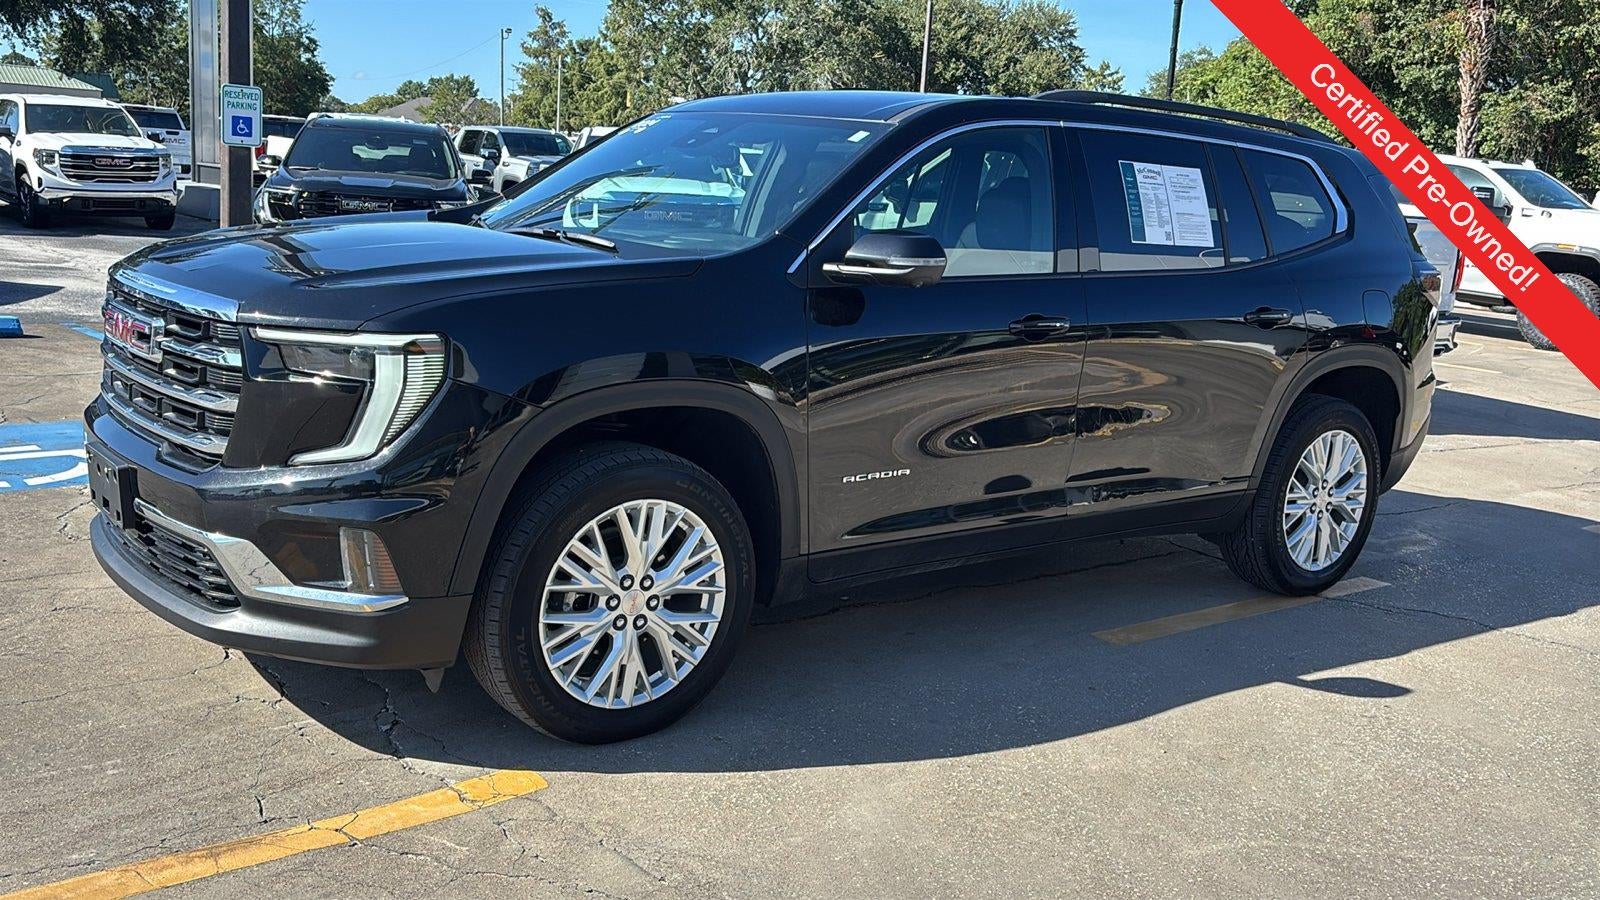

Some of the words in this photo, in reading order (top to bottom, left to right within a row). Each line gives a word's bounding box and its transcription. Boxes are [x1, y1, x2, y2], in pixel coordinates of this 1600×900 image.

[224, 90, 259, 101] RESERVED
[226, 101, 258, 111] PARKING
[95, 158, 131, 166] GMC
[342, 200, 389, 211] GMC
[644, 210, 693, 221] GMC
[104, 310, 151, 350] GMC
[842, 469, 911, 483] ACADIA
